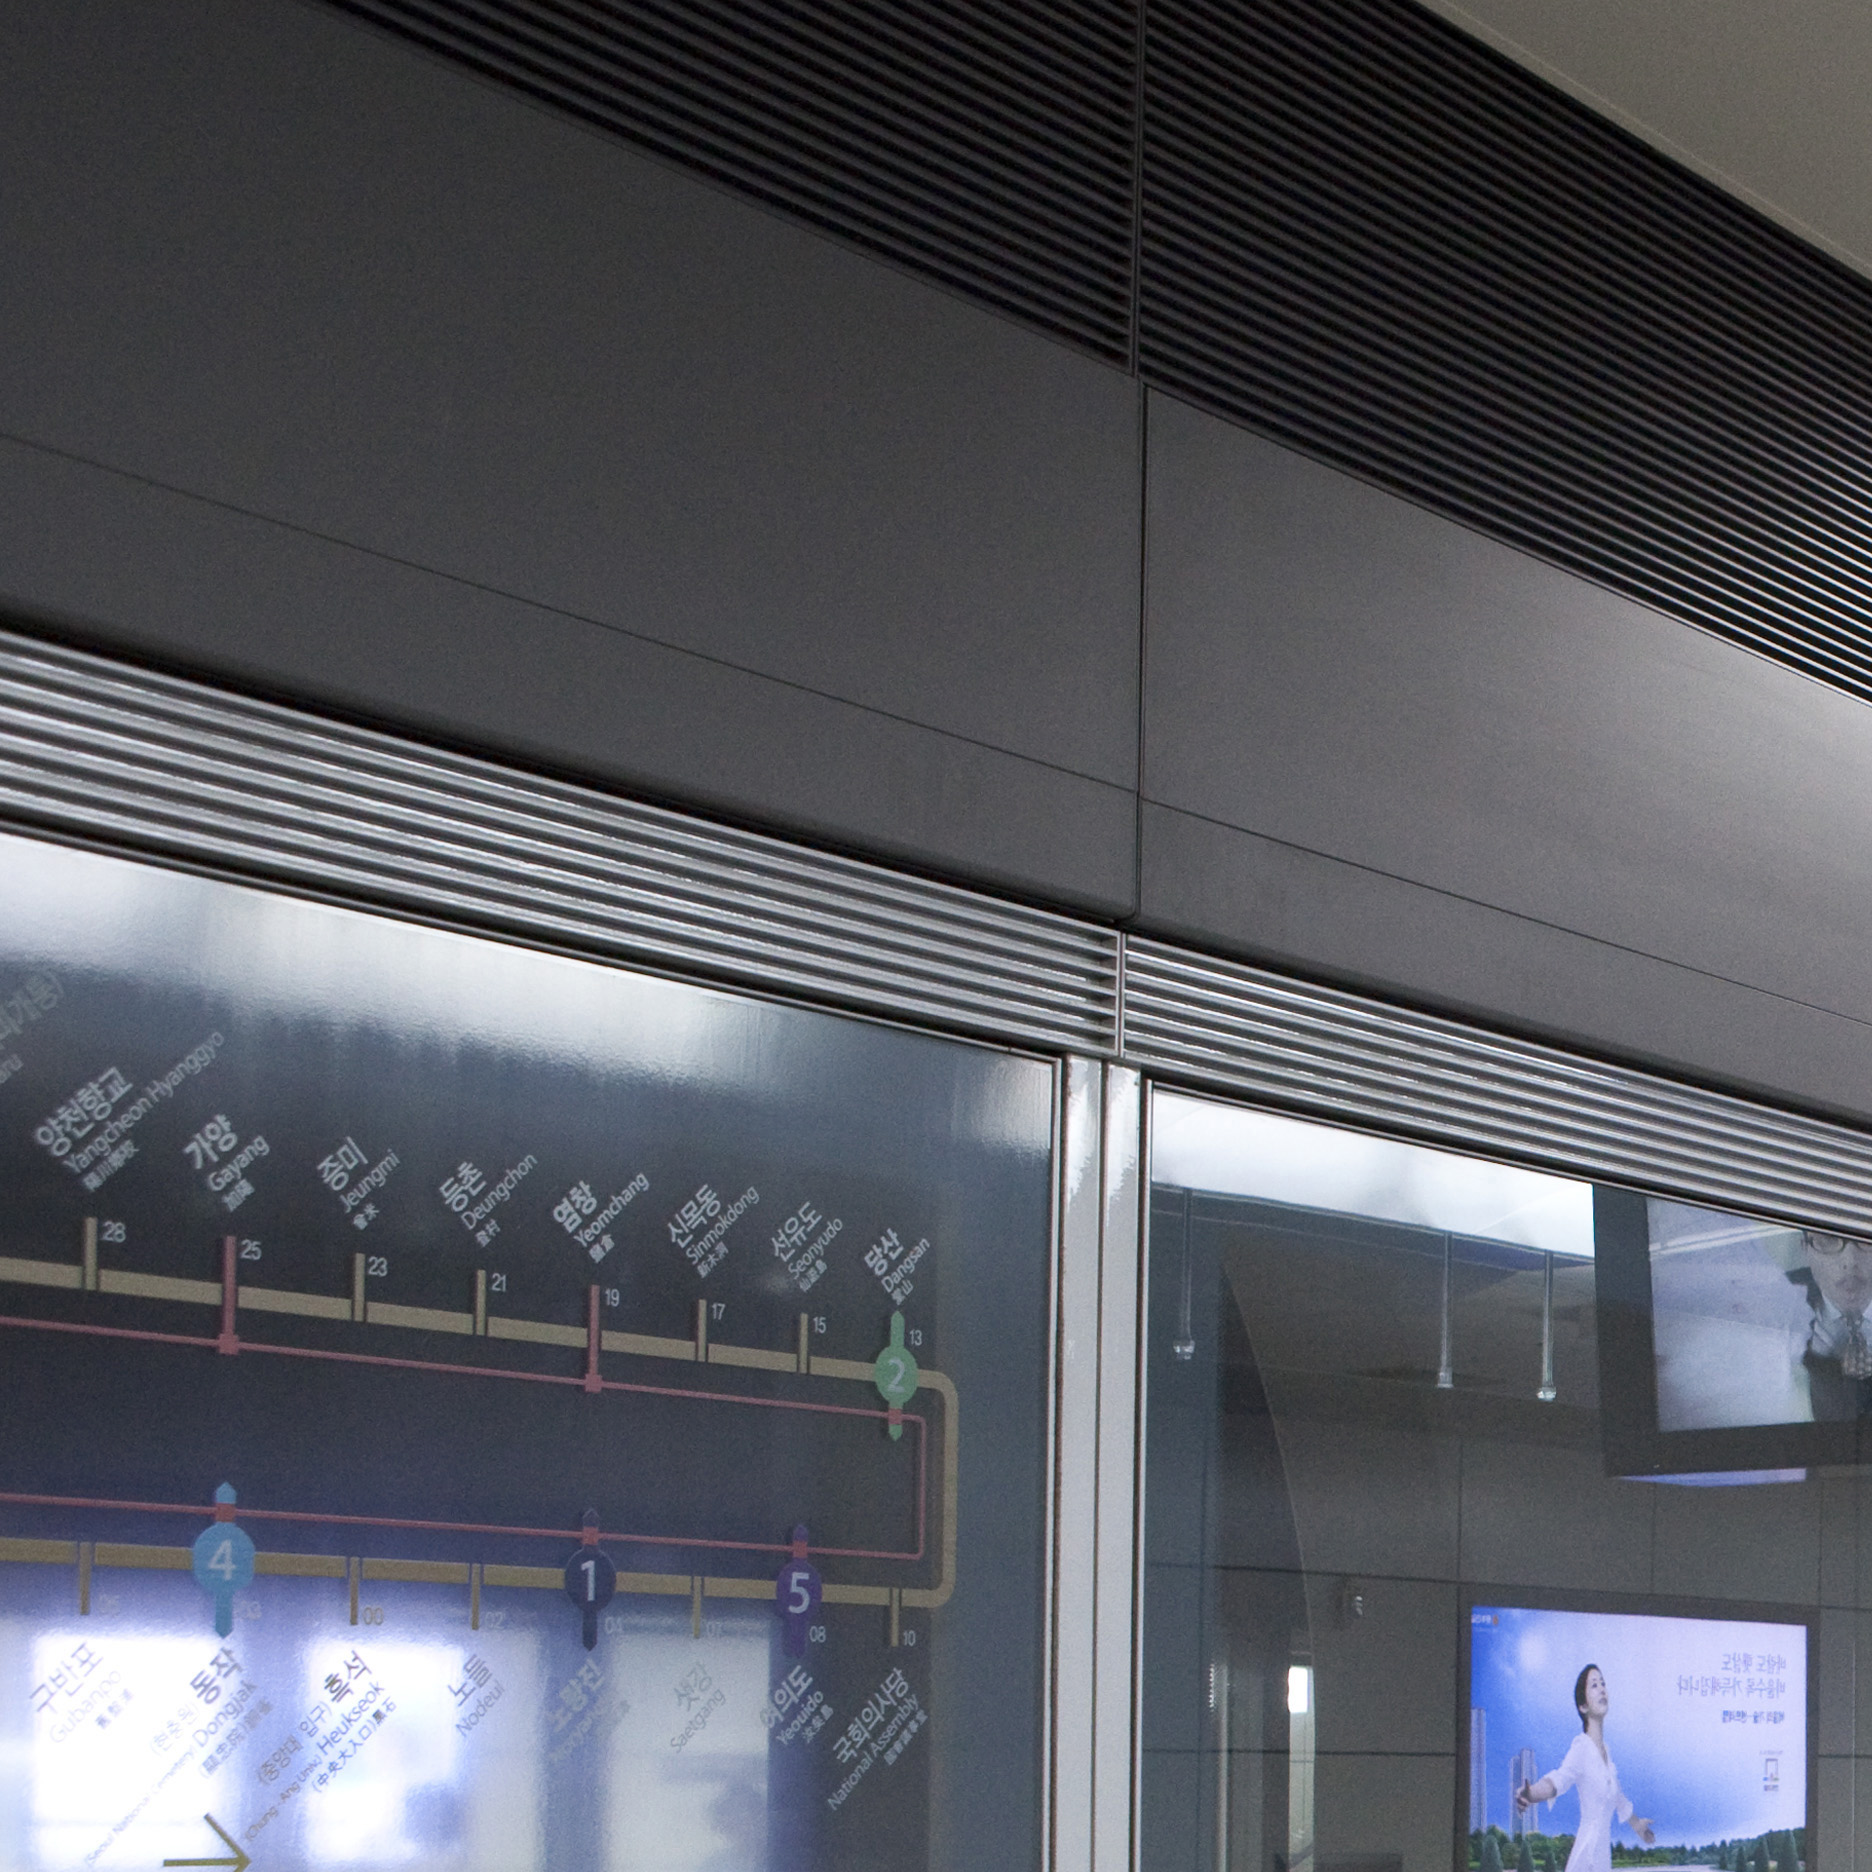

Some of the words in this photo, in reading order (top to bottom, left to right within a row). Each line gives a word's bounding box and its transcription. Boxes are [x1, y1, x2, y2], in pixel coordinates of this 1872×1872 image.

[35, 1066, 134, 1157] 양천향교
[62, 1086, 152, 1175] Yangcheon
[147, 1030, 225, 1103] Hyanggyo
[183, 1113, 238, 1170] 가양
[206, 1135, 270, 1194] Gayang
[316, 1136, 369, 1191] 증미
[338, 1148, 401, 1214] Jeungmi
[438, 1160, 487, 1213] 등촌
[460, 1153, 539, 1231] Deungchon
[552, 1180, 599, 1234] 염창
[101, 1220, 127, 1243] 28
[573, 1172, 650, 1249] Yeomchang
[666, 1184, 722, 1249] 신목동
[685, 1185, 760, 1267] Sinmokdong
[770, 1201, 823, 1263] 선유도
[240, 1239, 262, 1261] 25
[367, 1256, 389, 1277] 23
[788, 1216, 843, 1280] Seonyudo
[863, 1227, 905, 1277] 당산
[880, 1236, 931, 1294] Dangsan
[491, 1272, 508, 1292] 21
[604, 1288, 621, 1308] 19
[710, 1302, 726, 1321] 17
[813, 1316, 827, 1334] 15
[909, 1329, 923, 1346] 13
[888, 1358, 906, 1393] 2
[207, 1538, 238, 1581] 4
[580, 1560, 596, 1601] 1
[788, 1571, 811, 1615] 5
[809, 1626, 826, 1644] 08
[903, 1629, 917, 1647] 10
[29, 1642, 104, 1713] 구반포
[189, 1647, 243, 1706] 동작
[323, 1650, 373, 1705] 흑석
[447, 1652, 493, 1707] 노들
[759, 1665, 813, 1731] 여의도
[49, 1669, 123, 1744] Gubanpo
[193, 1679, 260, 1749] Dongjak
[317, 1680, 387, 1755] Heukseok
[455, 1681, 506, 1737] Nodeul
[669, 1685, 727, 1754] Saetgang
[776, 1687, 825, 1748] Yeouido
[832, 1667, 910, 1766] 국회의사당
[825, 1752, 878, 1810] National
[863, 1693, 925, 1758] Assembly
